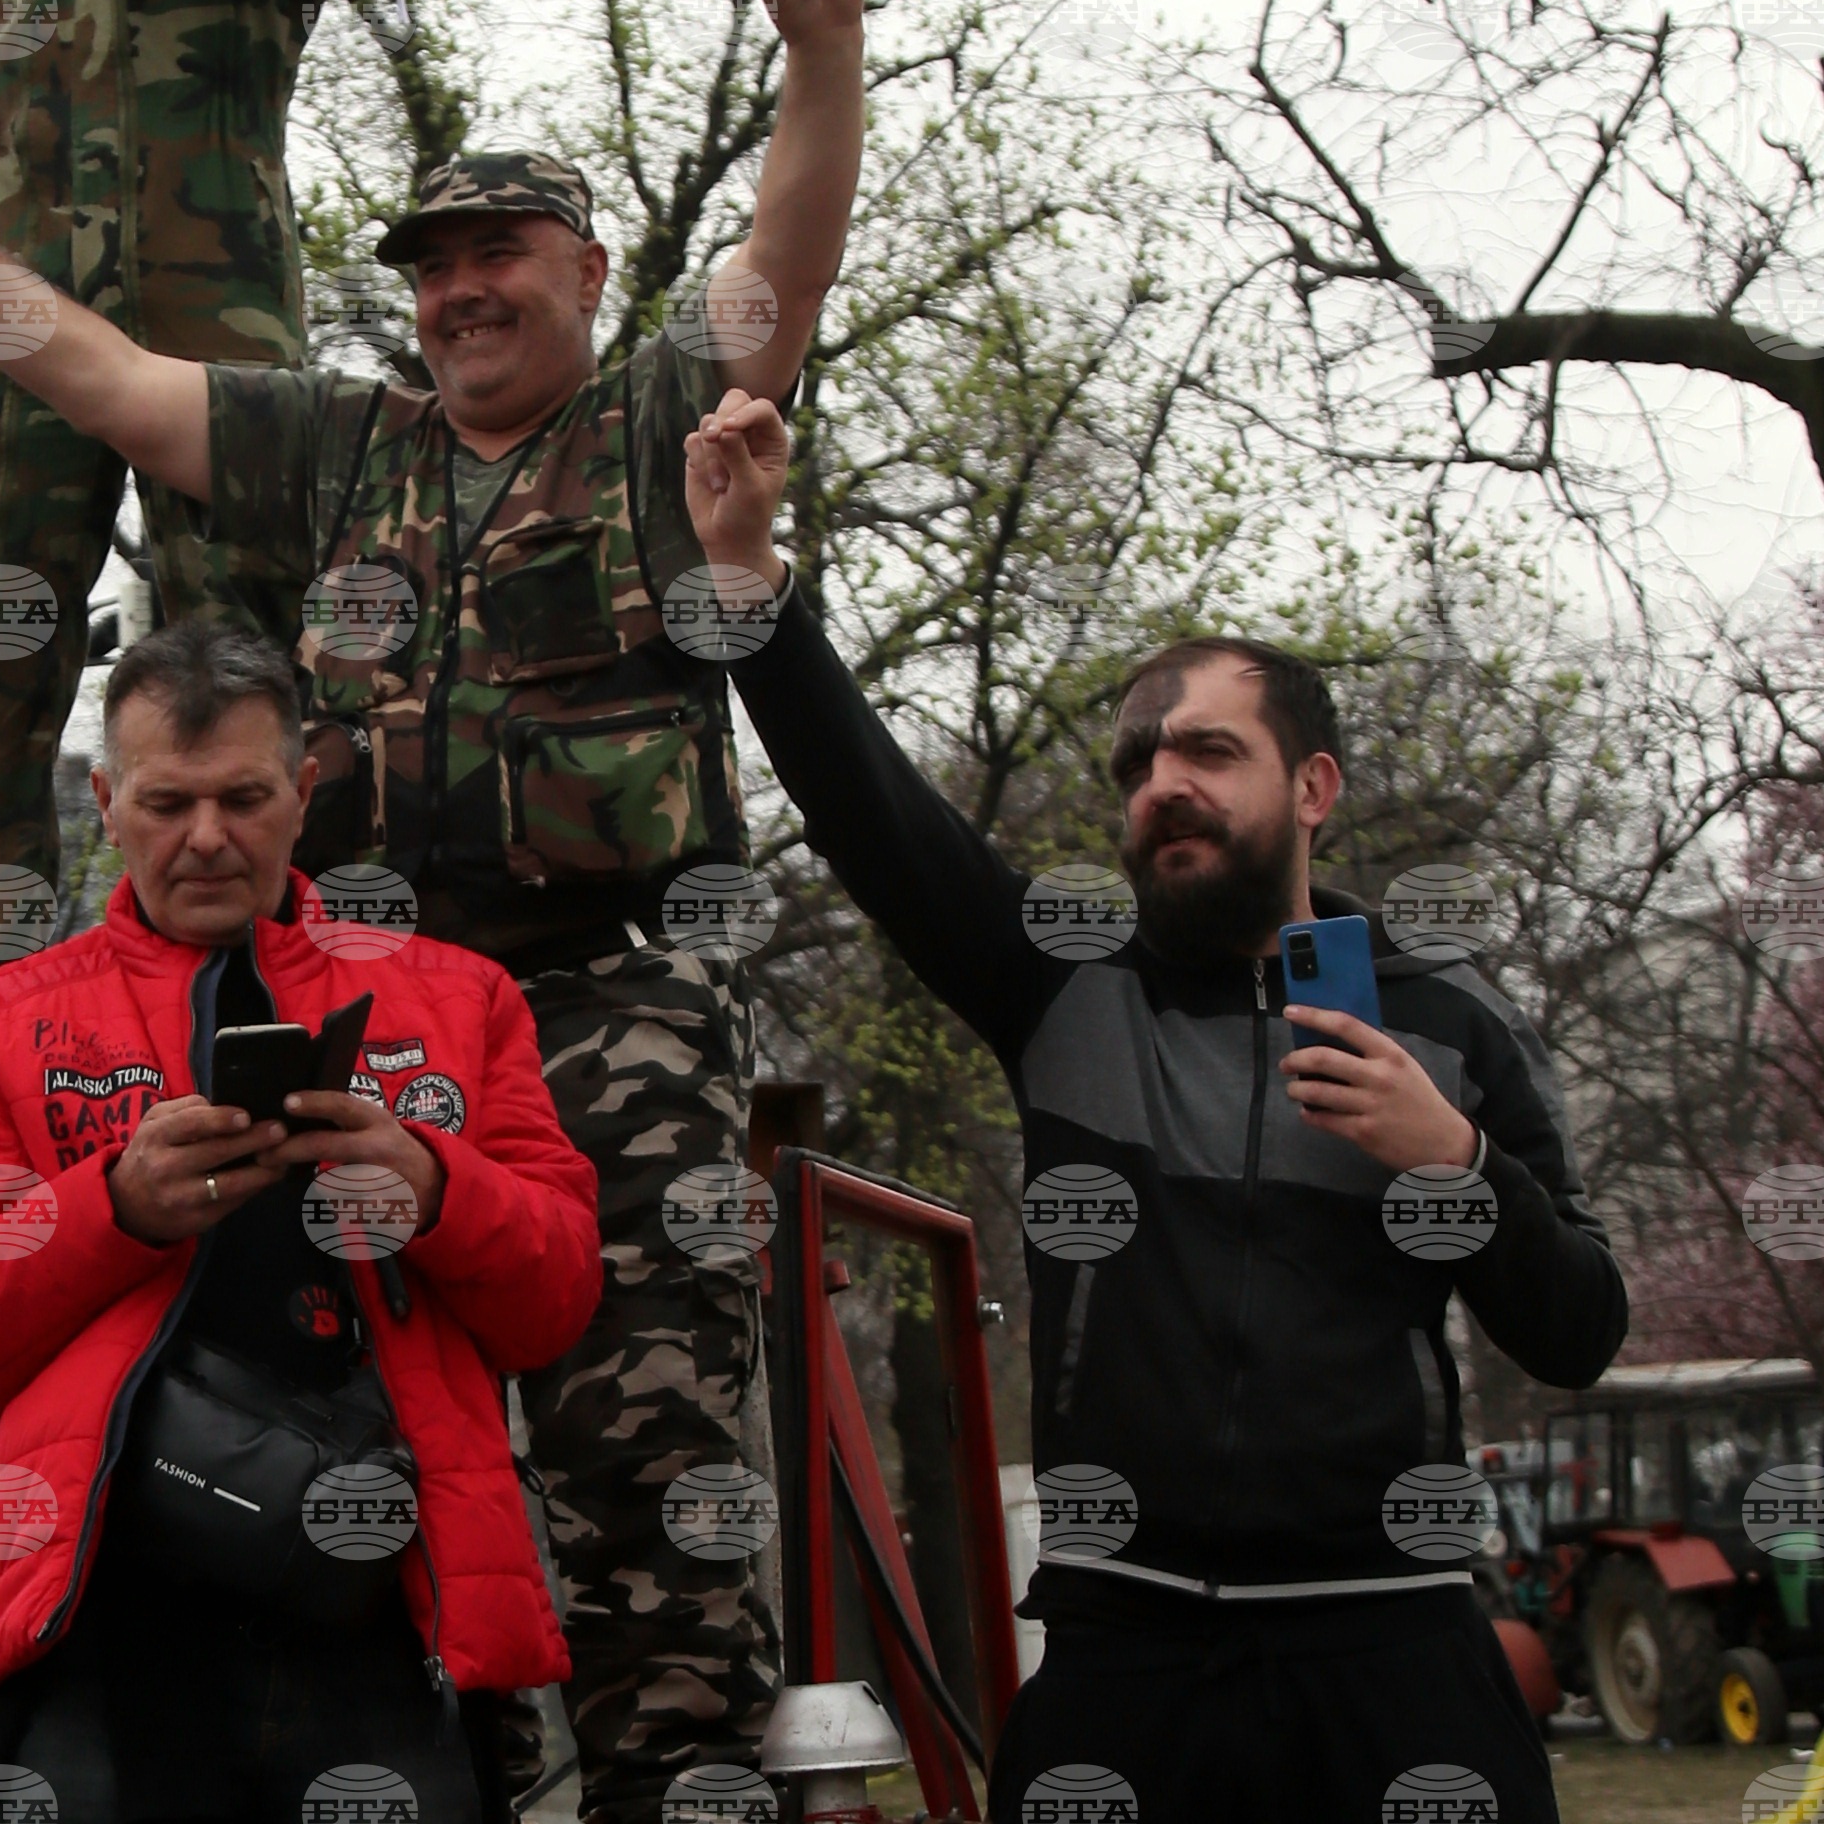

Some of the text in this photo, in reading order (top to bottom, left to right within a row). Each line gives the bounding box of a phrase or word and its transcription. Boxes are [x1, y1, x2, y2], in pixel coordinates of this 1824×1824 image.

[52, 1066, 159, 1096] ALASKA TOUR
[154, 1458, 206, 1489] FASHION
